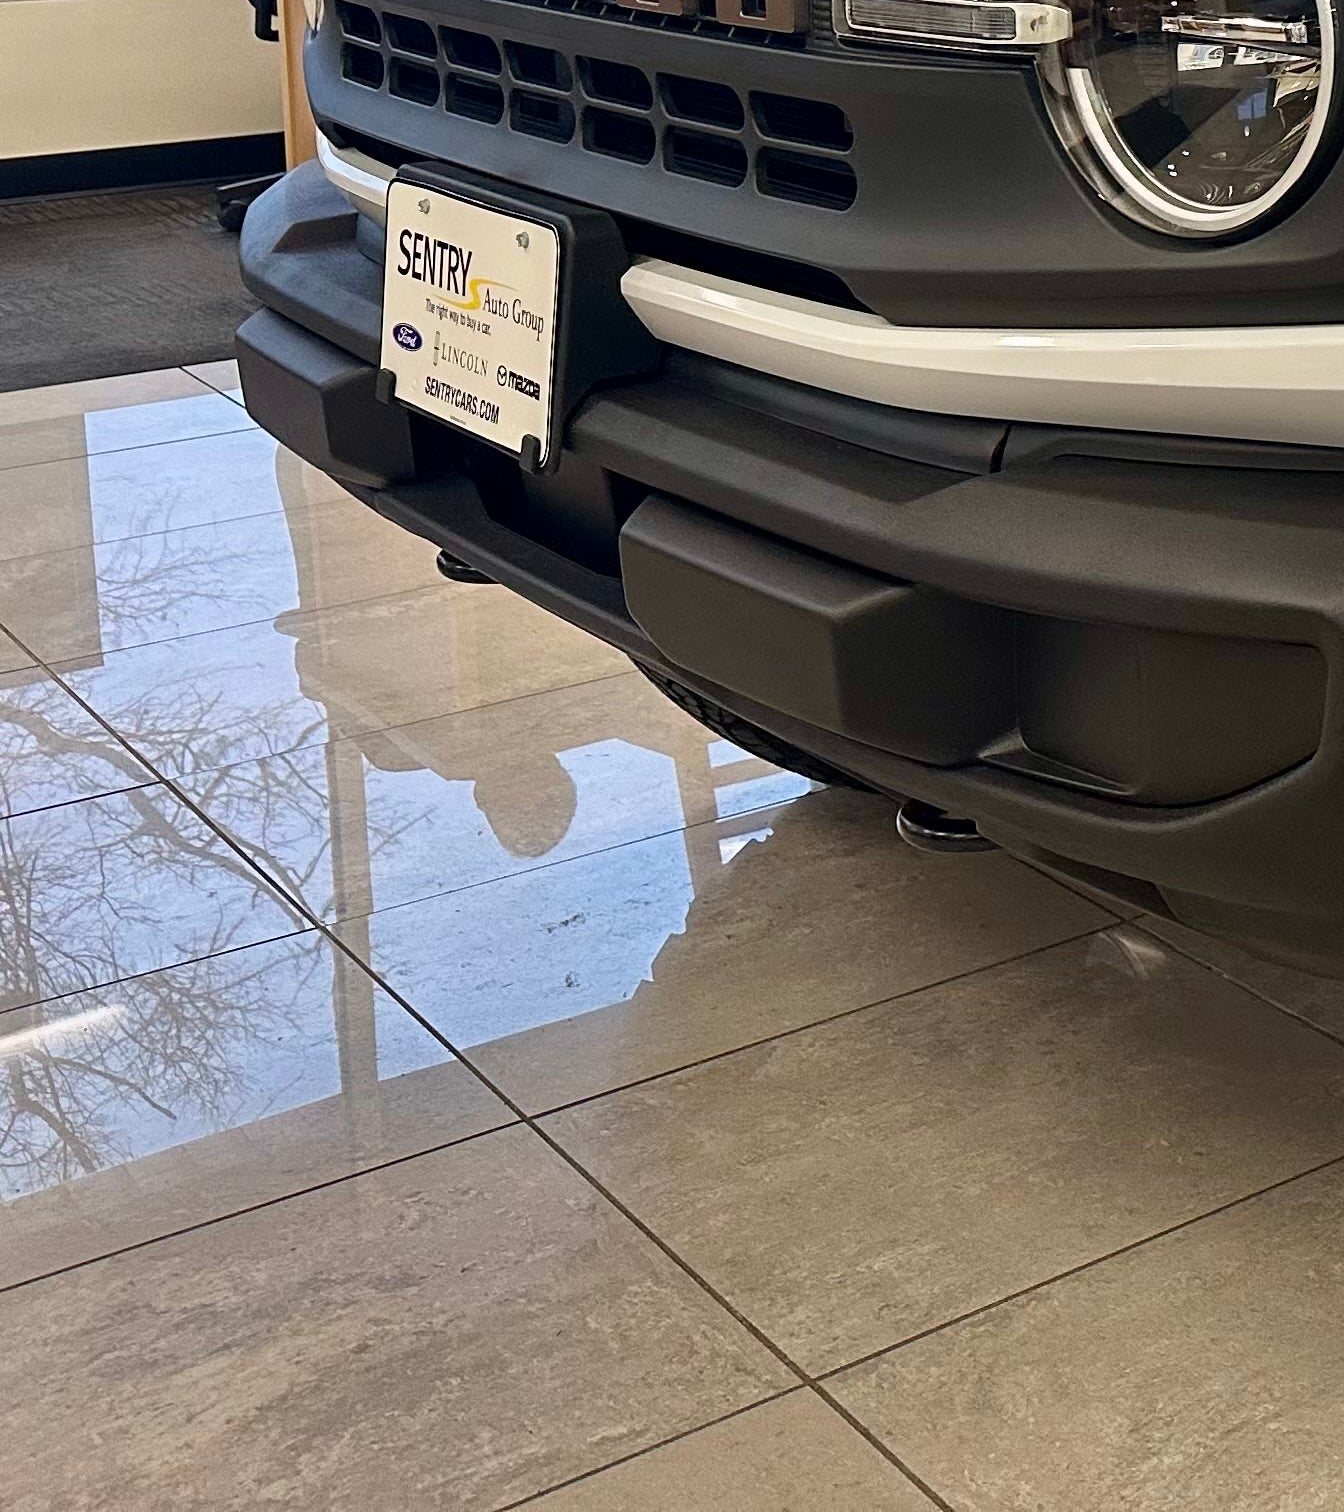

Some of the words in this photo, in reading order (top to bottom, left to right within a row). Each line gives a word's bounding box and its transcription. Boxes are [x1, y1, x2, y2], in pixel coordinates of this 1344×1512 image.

[397, 228, 473, 297] SENTRY
[425, 298, 435, 314] The
[436, 305, 448, 320] right
[449, 311, 459, 325] way
[466, 314, 476, 333] buy
[482, 288, 509, 319] Auto
[512, 298, 545, 342] Group
[441, 342, 489, 377] LINCOLN
[424, 376, 500, 424] SENTRYCARS.COM
